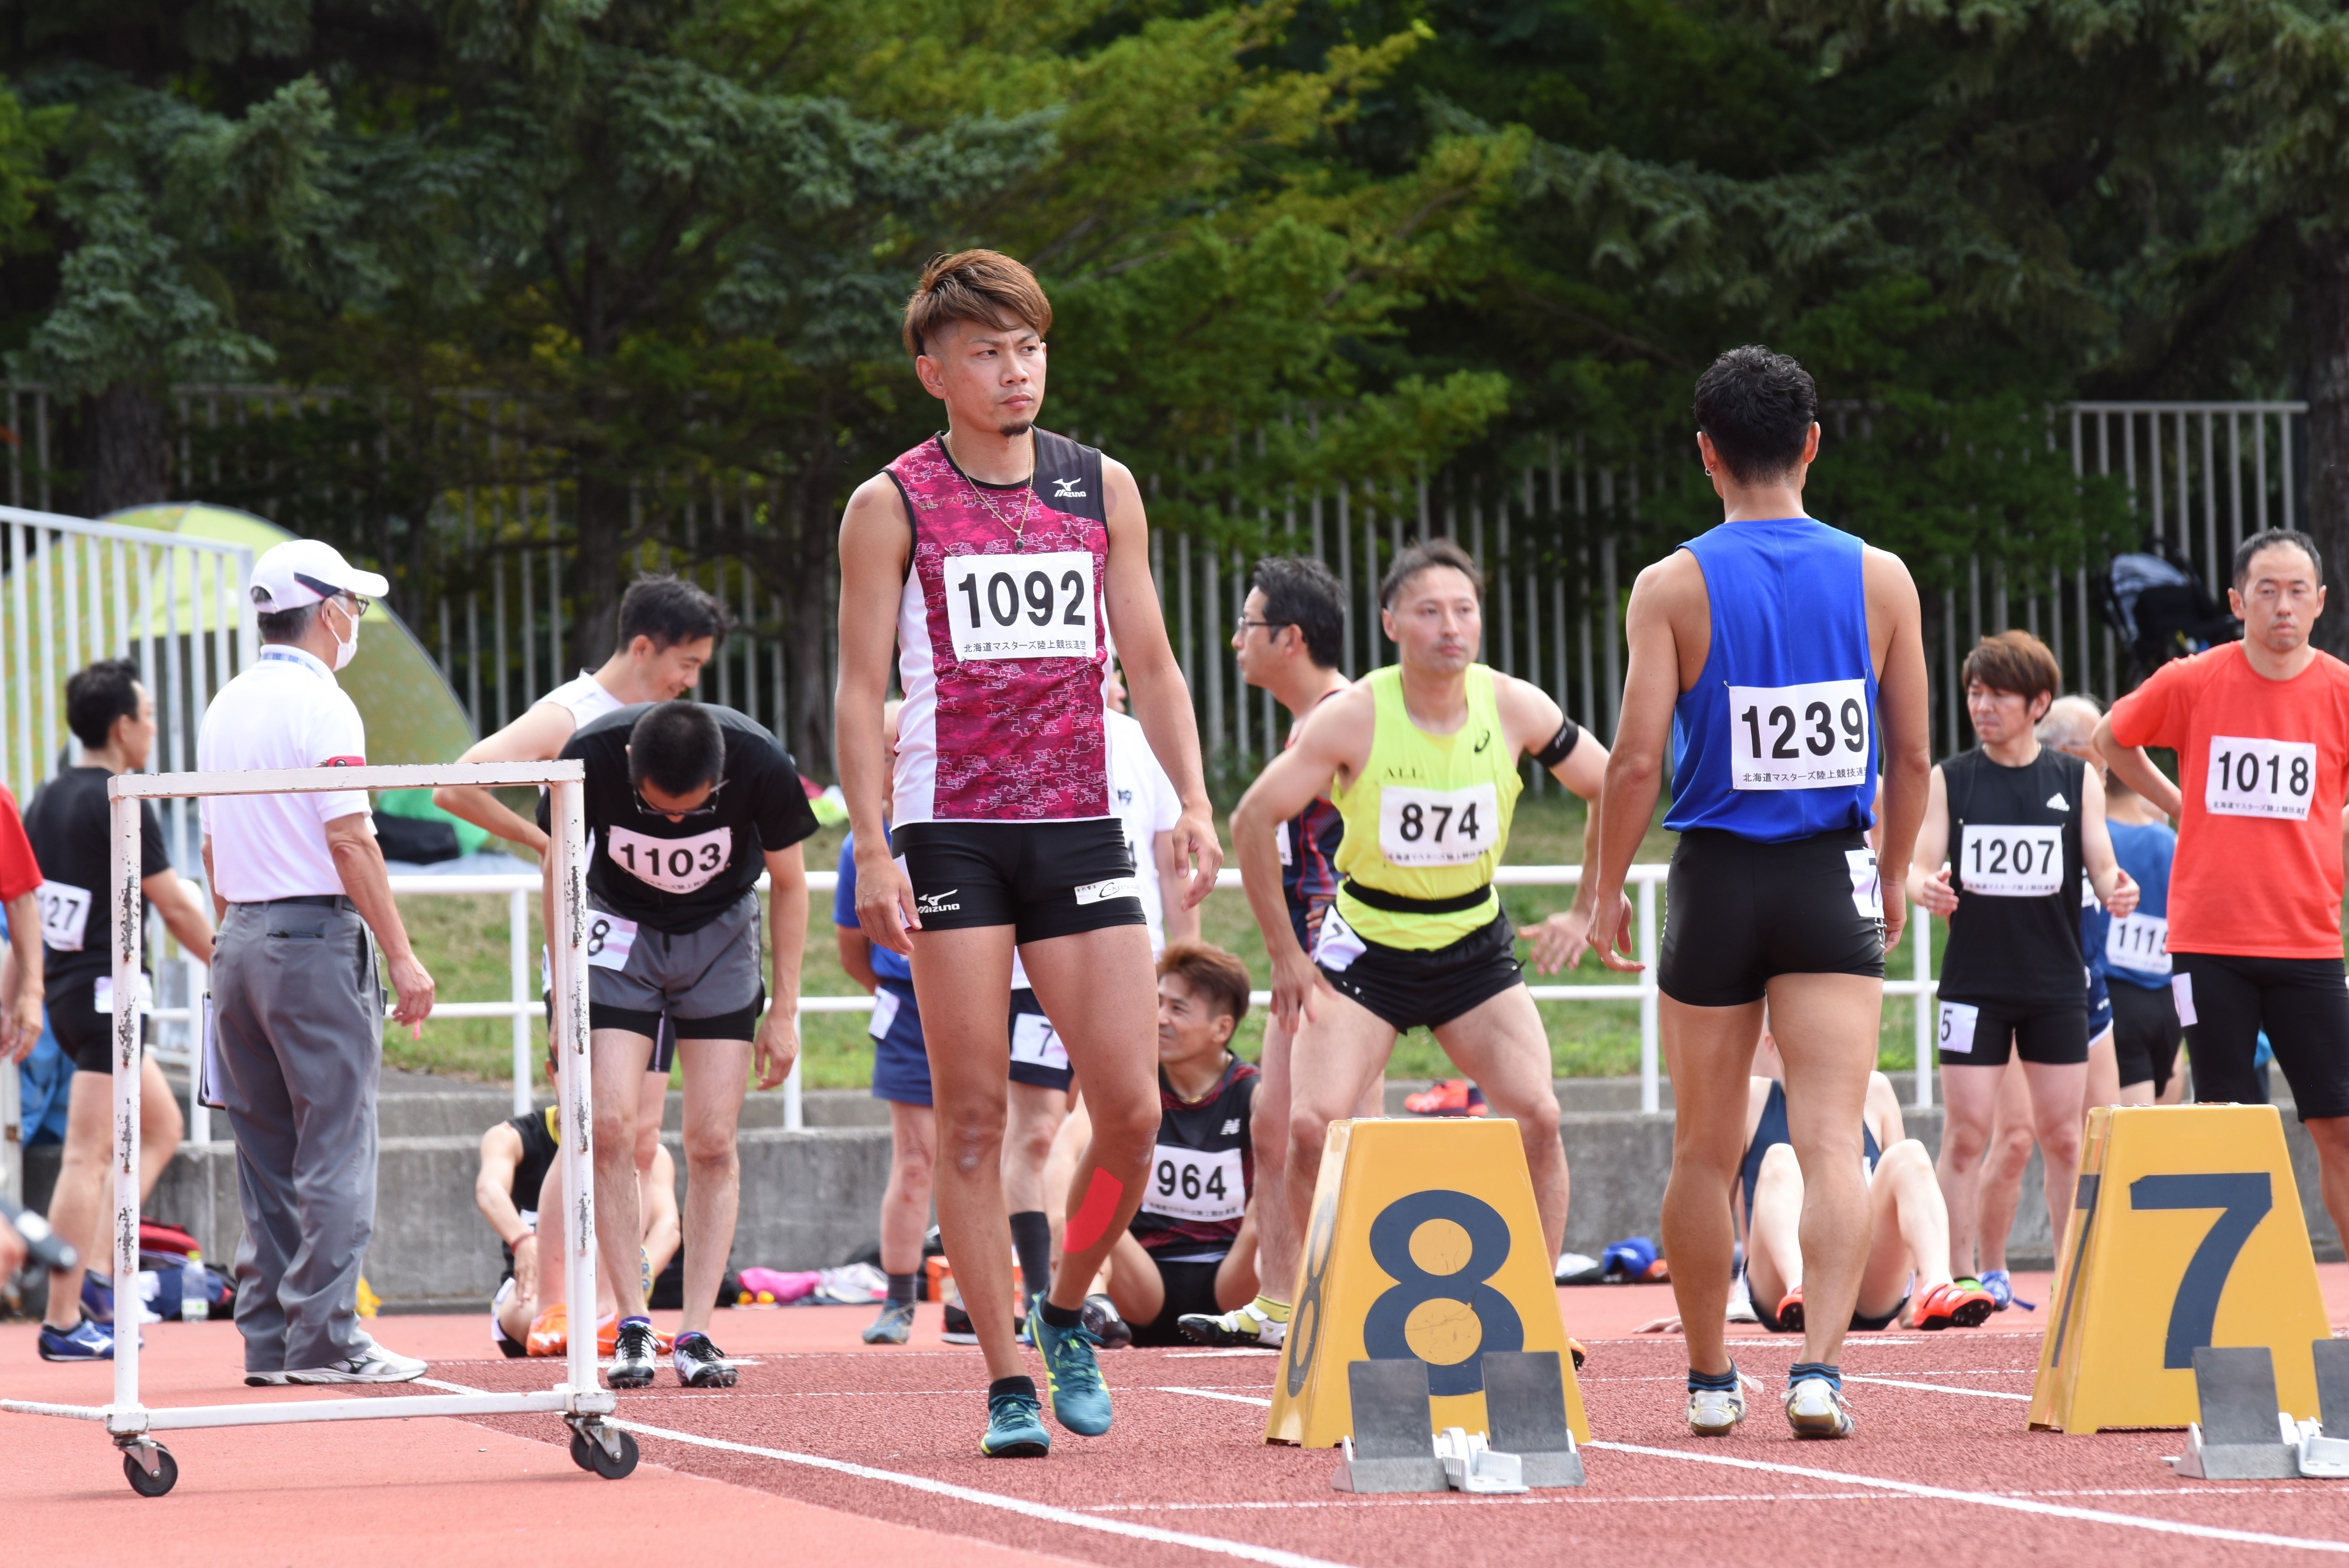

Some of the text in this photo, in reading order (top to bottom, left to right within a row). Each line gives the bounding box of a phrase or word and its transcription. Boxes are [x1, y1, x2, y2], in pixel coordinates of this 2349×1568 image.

[958, 570, 1085, 628] 1092
[1742, 698, 1864, 759] 1239
[2219, 751, 2308, 796] 1018
[1400, 802, 1479, 843] 874
[620, 843, 721, 878] 1103
[1971, 838, 2054, 875] 1207
[588, 919, 610, 957] 8
[1040, 1023, 1054, 1057] 7
[1941, 1009, 1953, 1041] 5
[1157, 1159, 1226, 1201] 964
[2130, 1172, 2272, 1369] 7
[1288, 1192, 1335, 1397] 8
[1363, 1190, 1524, 1396] 8
